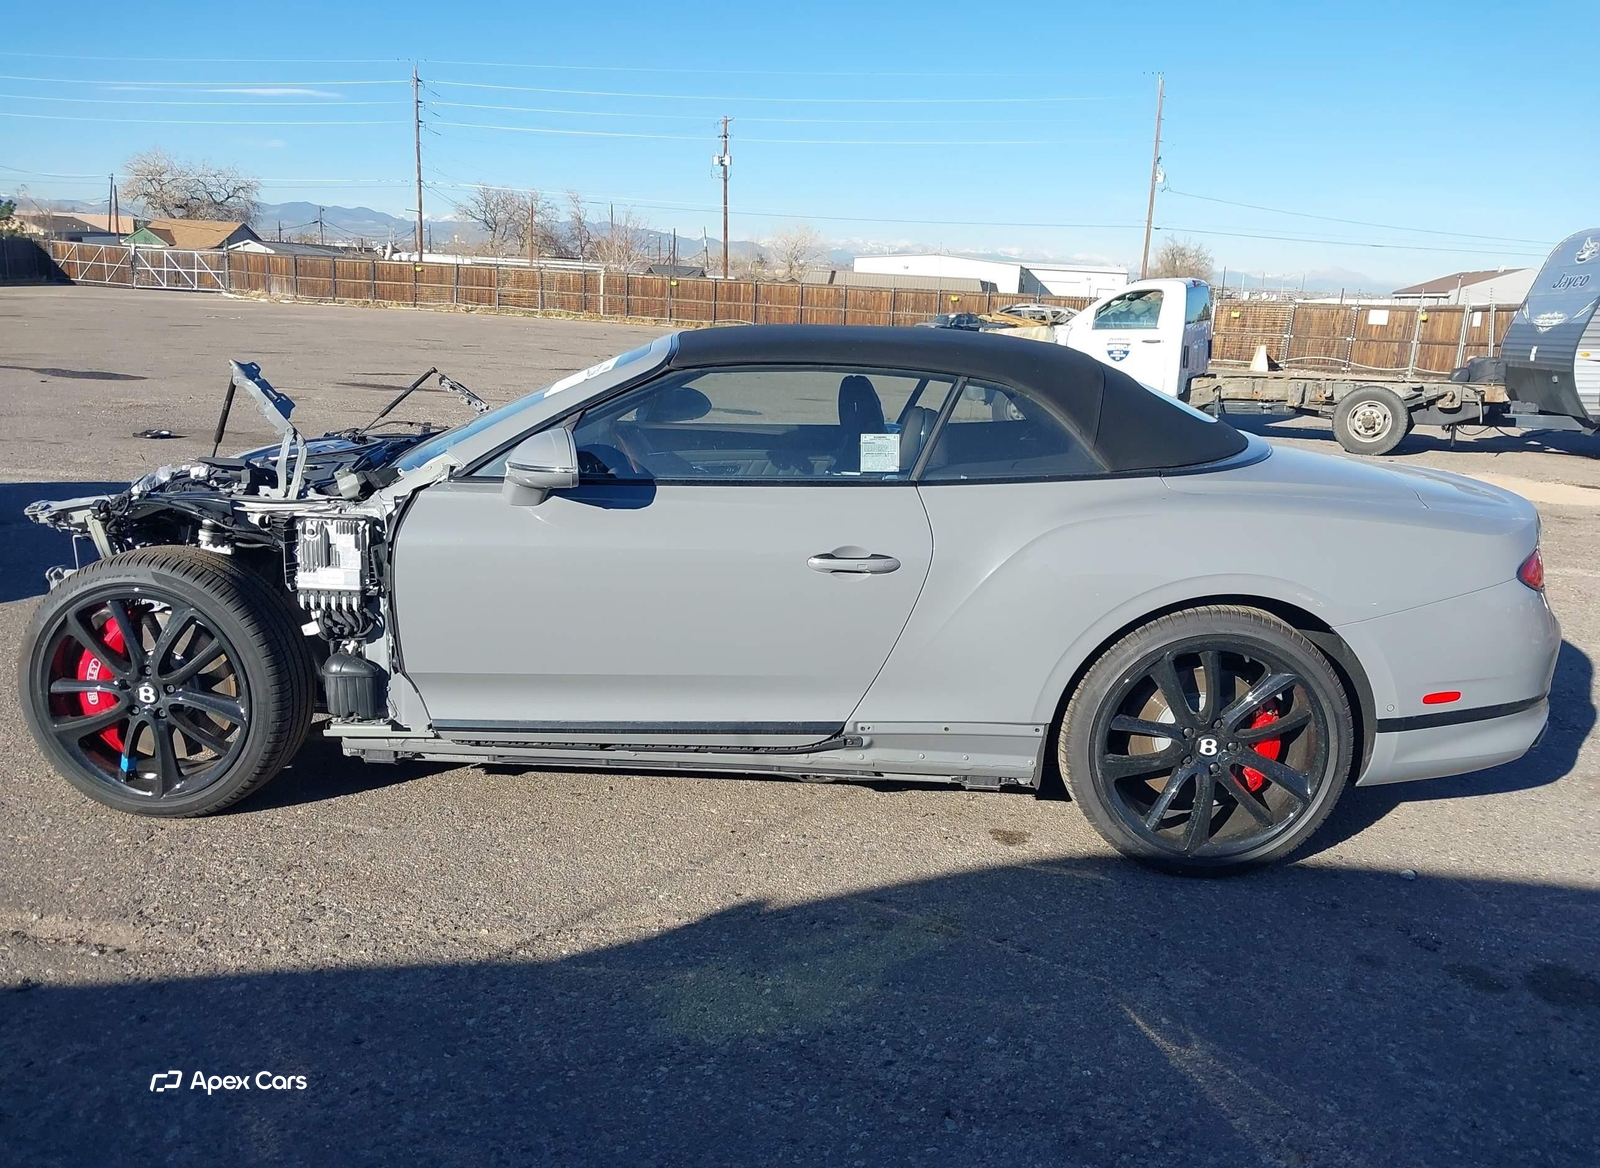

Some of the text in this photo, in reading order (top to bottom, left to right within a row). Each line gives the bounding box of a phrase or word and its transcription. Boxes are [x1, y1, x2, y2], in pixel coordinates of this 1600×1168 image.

[1552, 273, 1590, 291] Jayco
[138, 686, 155, 703] B
[1199, 738, 1217, 756] B
